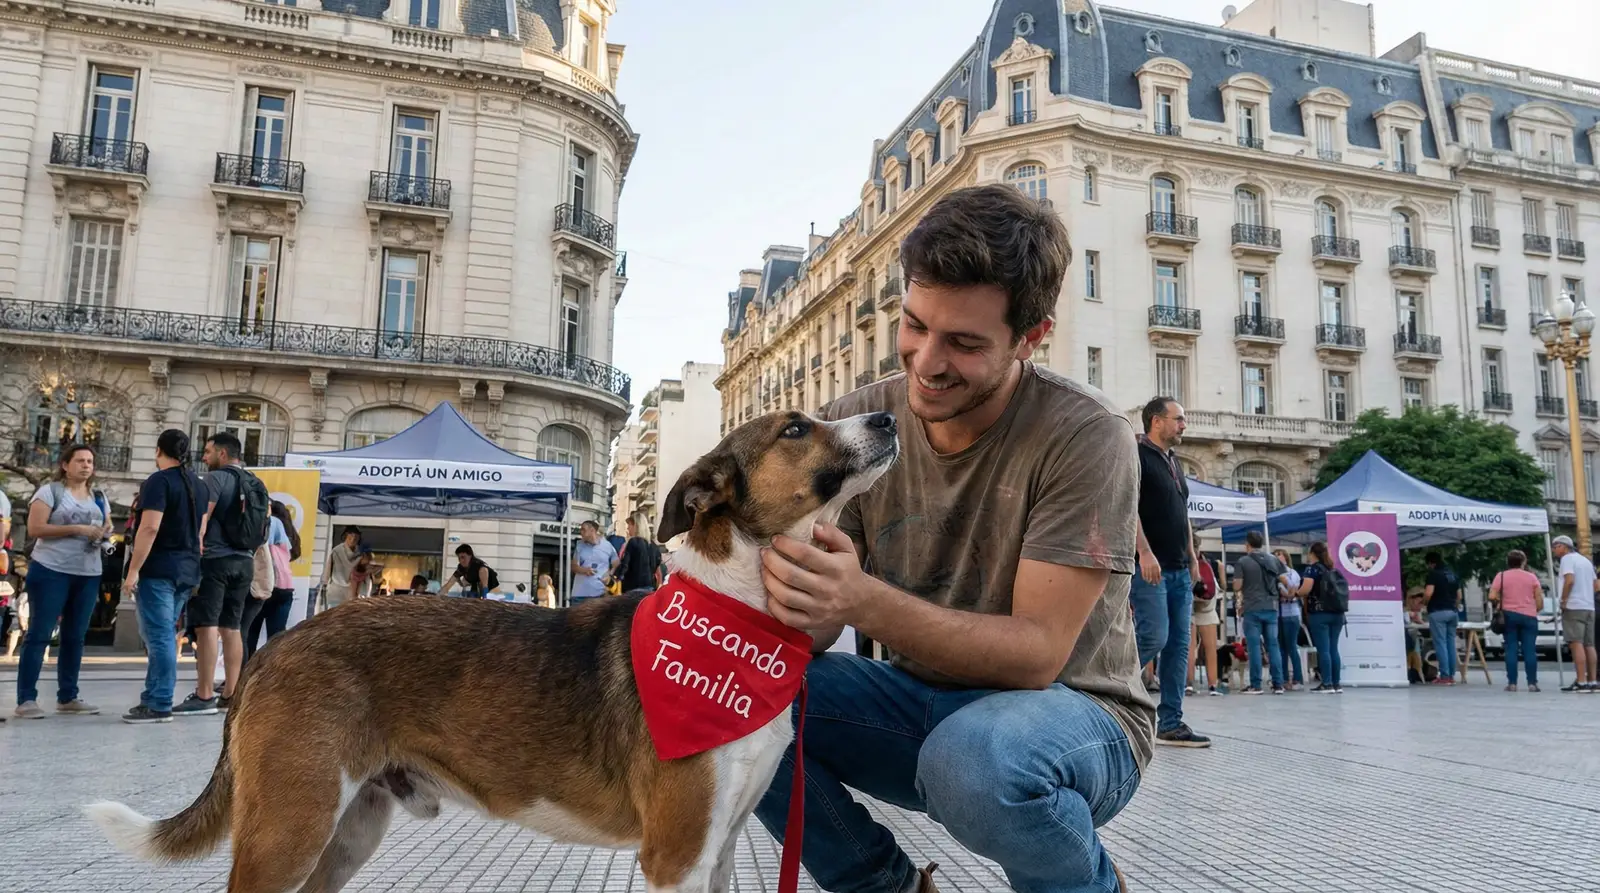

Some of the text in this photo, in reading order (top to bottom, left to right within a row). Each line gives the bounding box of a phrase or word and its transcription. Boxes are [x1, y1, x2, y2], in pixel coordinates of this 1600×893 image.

[358, 464, 502, 482] ADOPTÁ UN AMIGO
[1187, 502, 1214, 512] MIGO
[1408, 509, 1502, 524] ADOPTÁ UN AMIGO
[657, 591, 787, 679] Buscando
[651, 639, 752, 719] Familia
